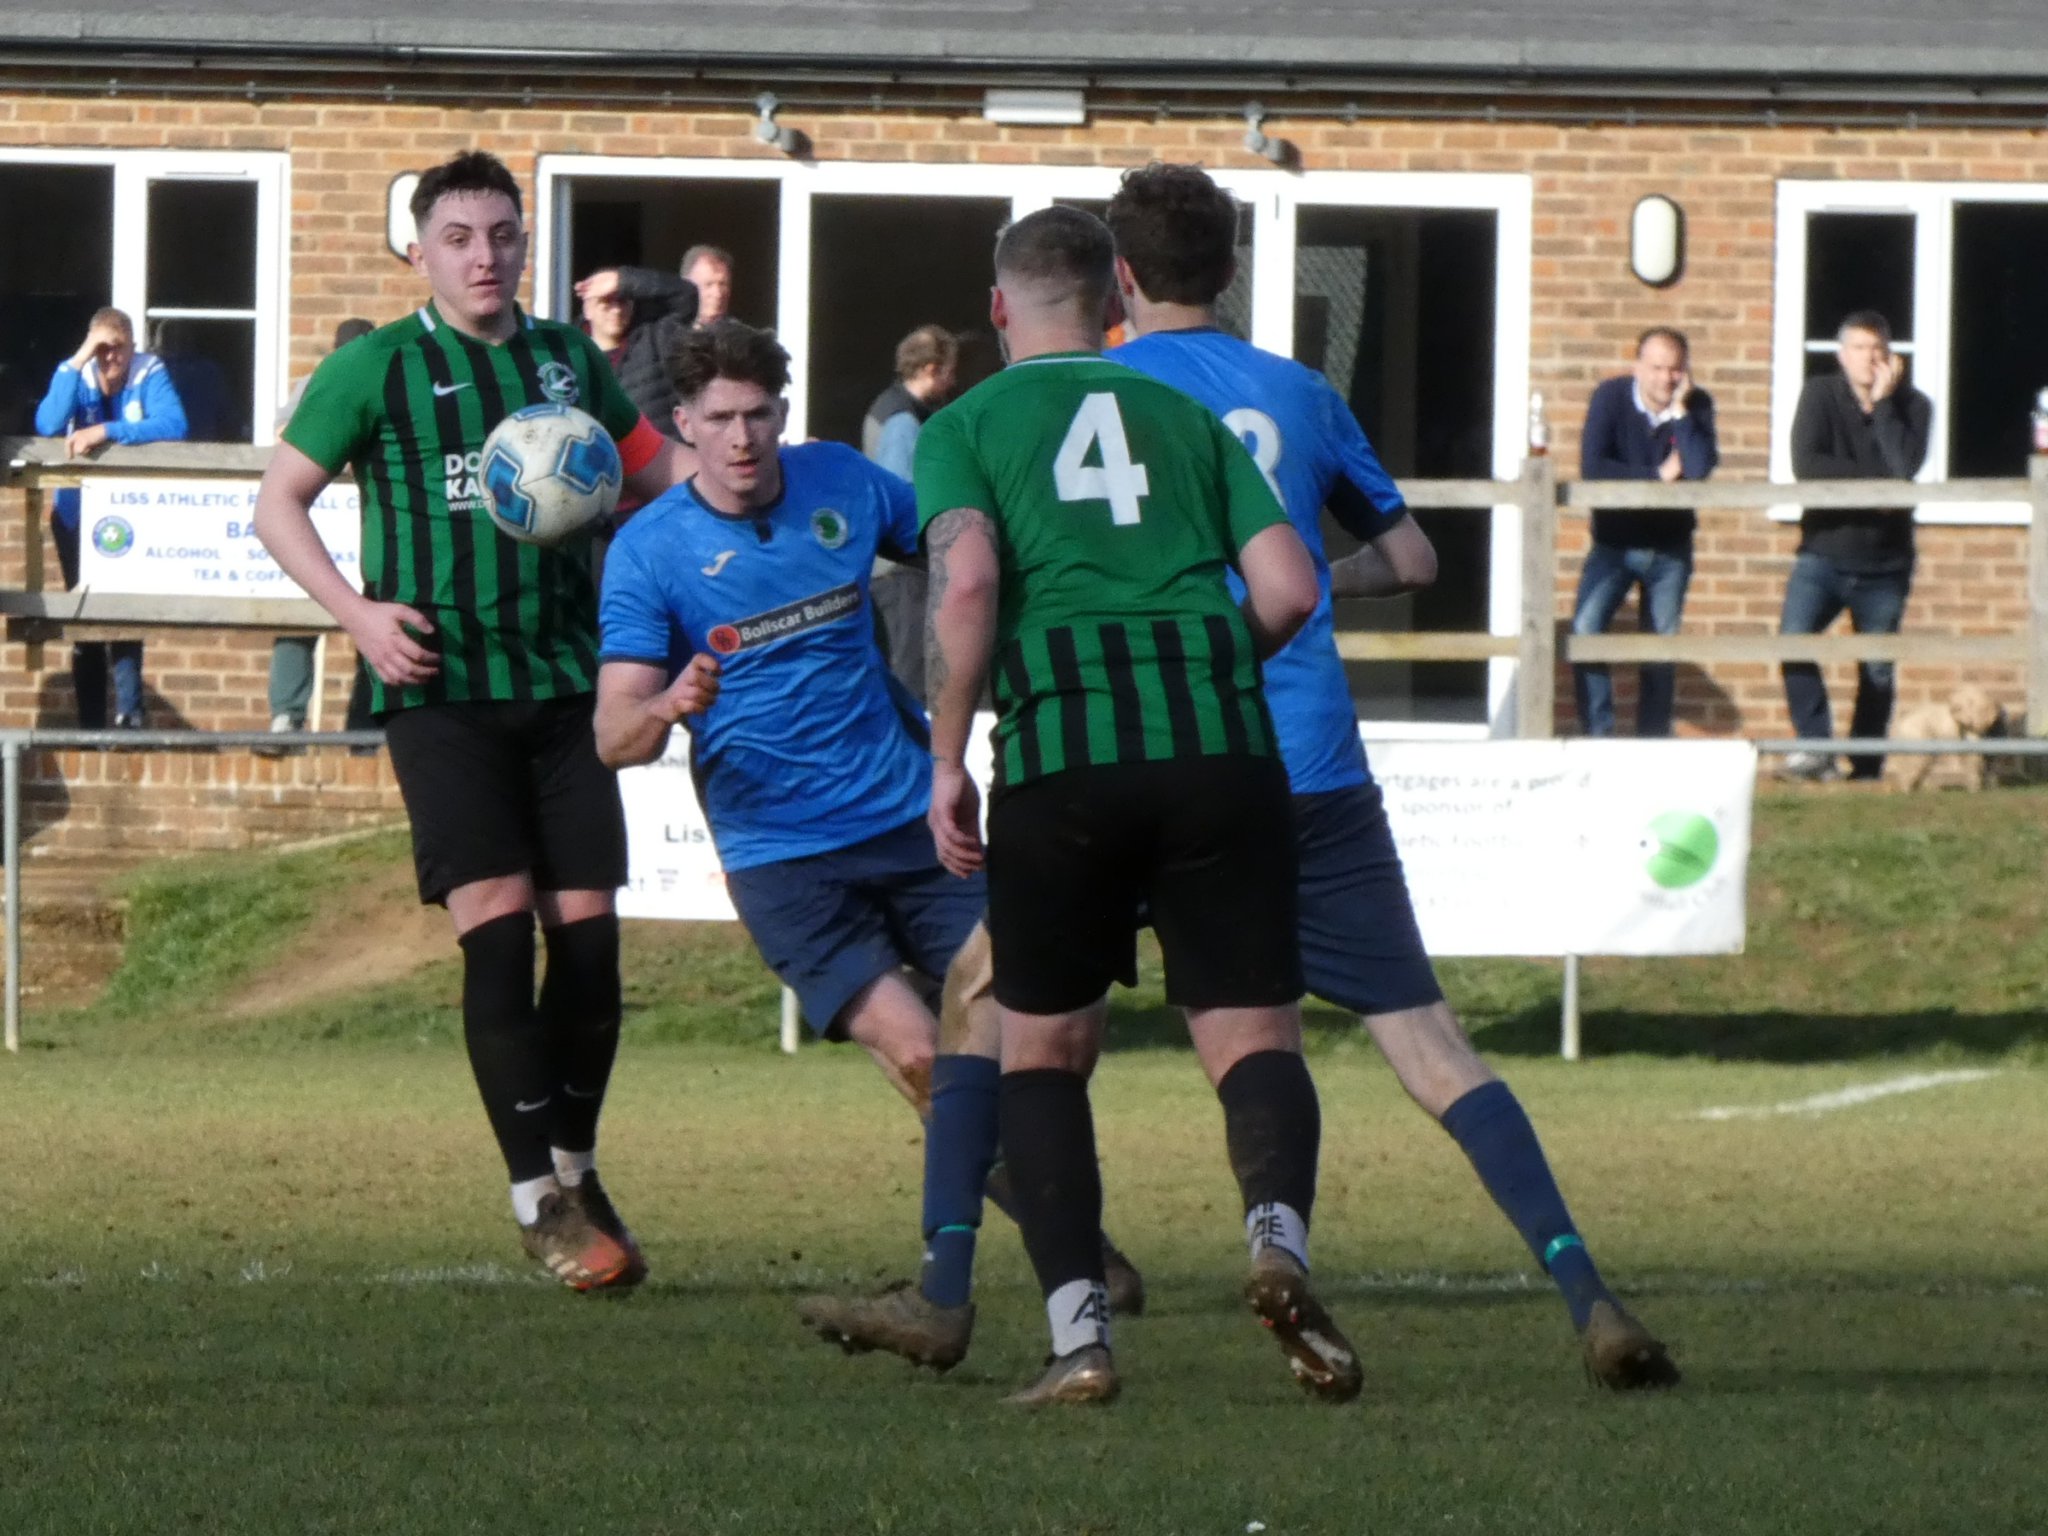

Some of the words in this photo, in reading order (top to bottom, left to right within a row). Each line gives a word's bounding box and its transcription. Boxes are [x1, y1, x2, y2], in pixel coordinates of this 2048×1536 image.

[445, 451, 482, 475] DO
[1053, 391, 1150, 525] 4
[446, 477, 480, 500] KA
[110, 492, 149, 505] LISS
[156, 493, 240, 507] ATHLETIC
[226, 521, 256, 538] BA
[145, 547, 221, 560] ALCOHOL
[247, 549, 268, 561] SO
[194, 569, 221, 580] TEA
[228, 570, 239, 580] &
[245, 571, 285, 581] COFF
[665, 824, 706, 843] Lis
